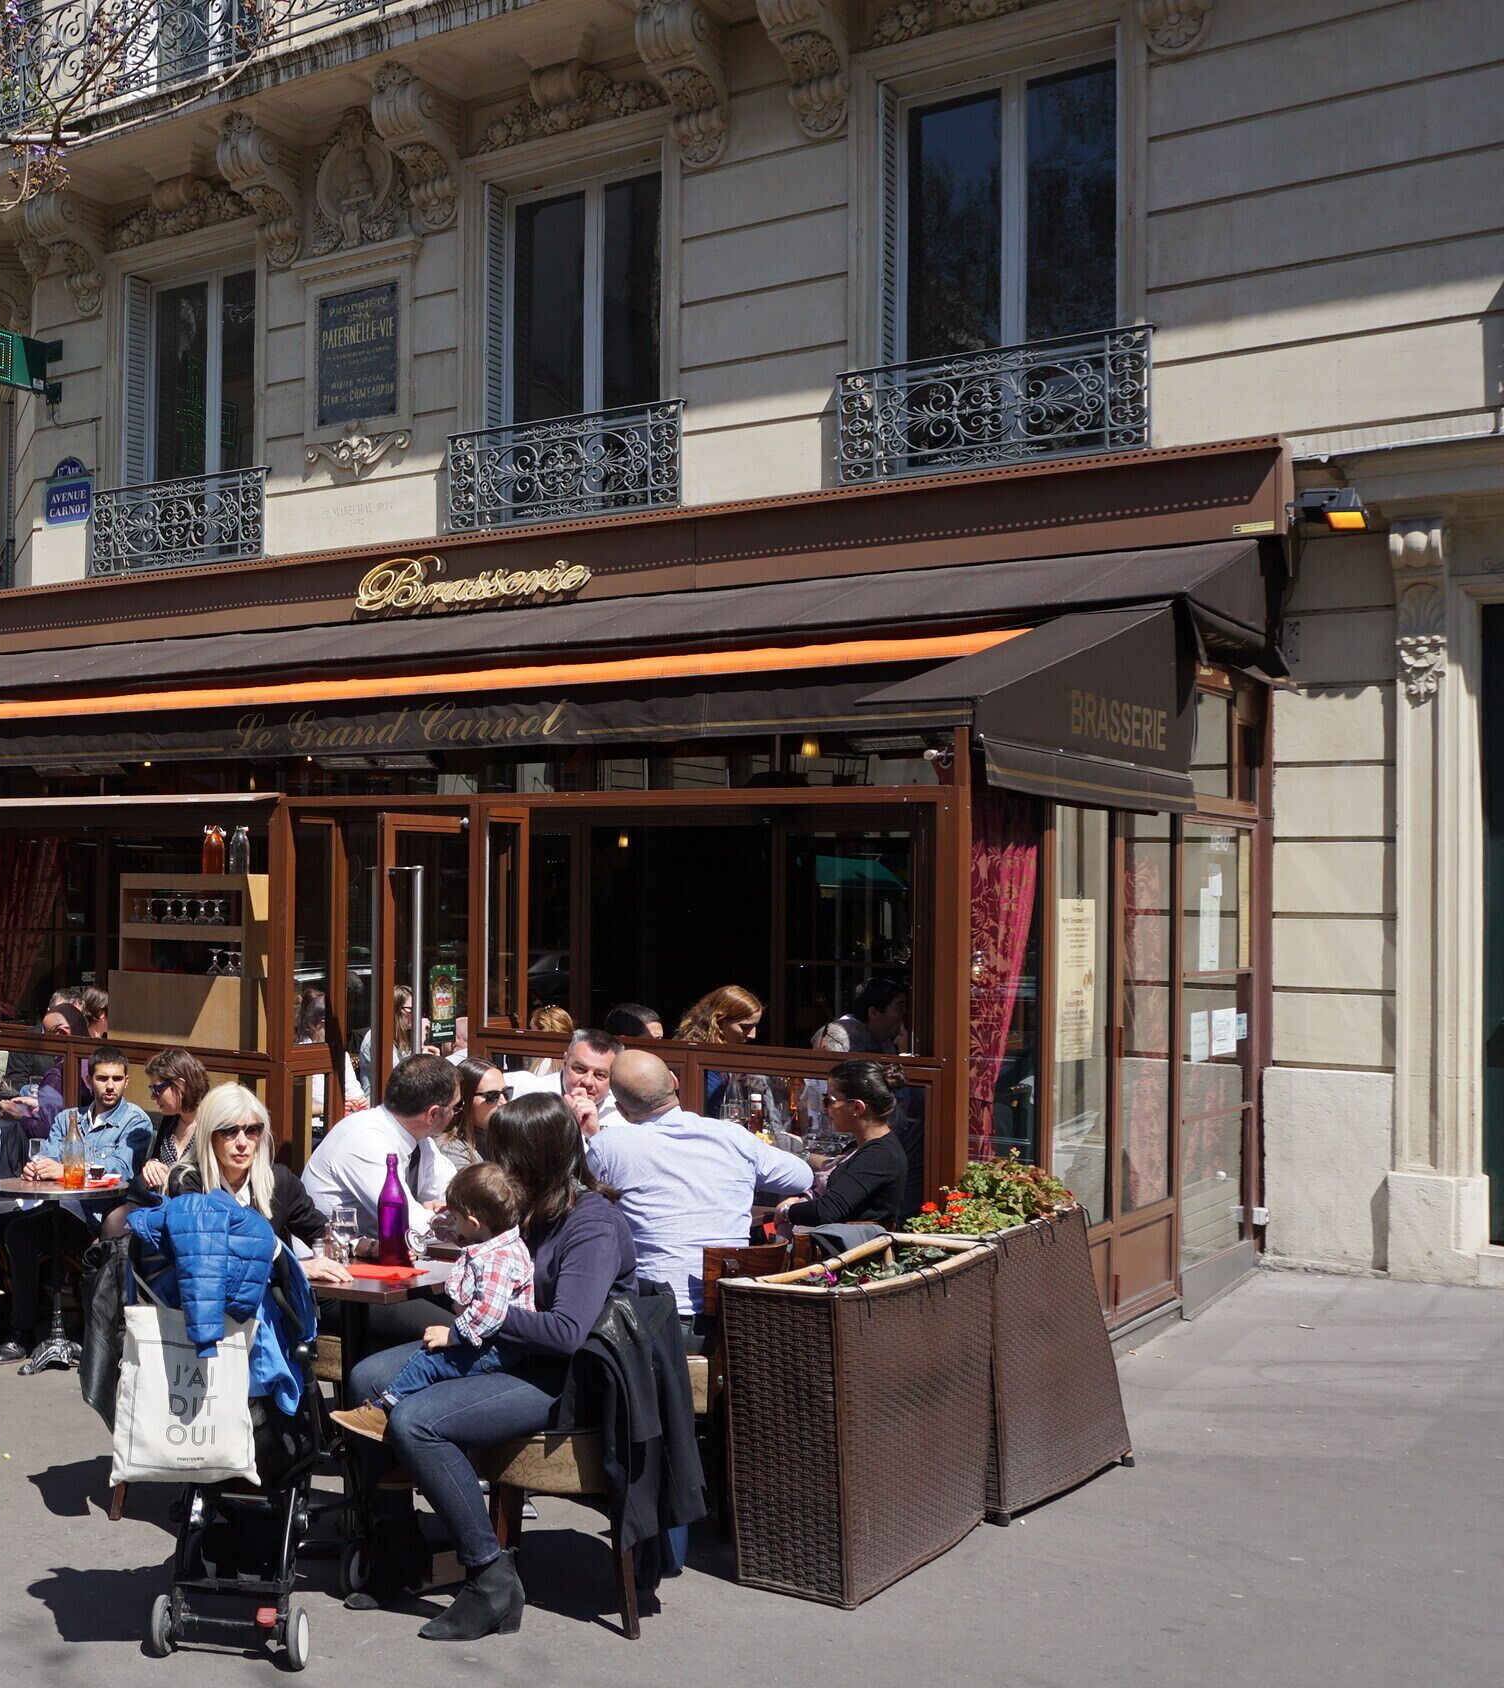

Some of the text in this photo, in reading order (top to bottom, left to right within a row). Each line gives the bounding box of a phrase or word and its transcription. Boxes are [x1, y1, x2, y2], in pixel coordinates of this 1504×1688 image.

[50, 490, 87, 504] AVENUE
[49, 503, 87, 518] CARNOT
[355, 555, 592, 610] Brasserie
[230, 699, 568, 751] Le Grand Carnot
[1071, 689, 1167, 751] BRASSERIE
[173, 1364, 215, 1389] J'AI
[169, 1393, 218, 1418] DIT
[166, 1424, 216, 1447] OUI
